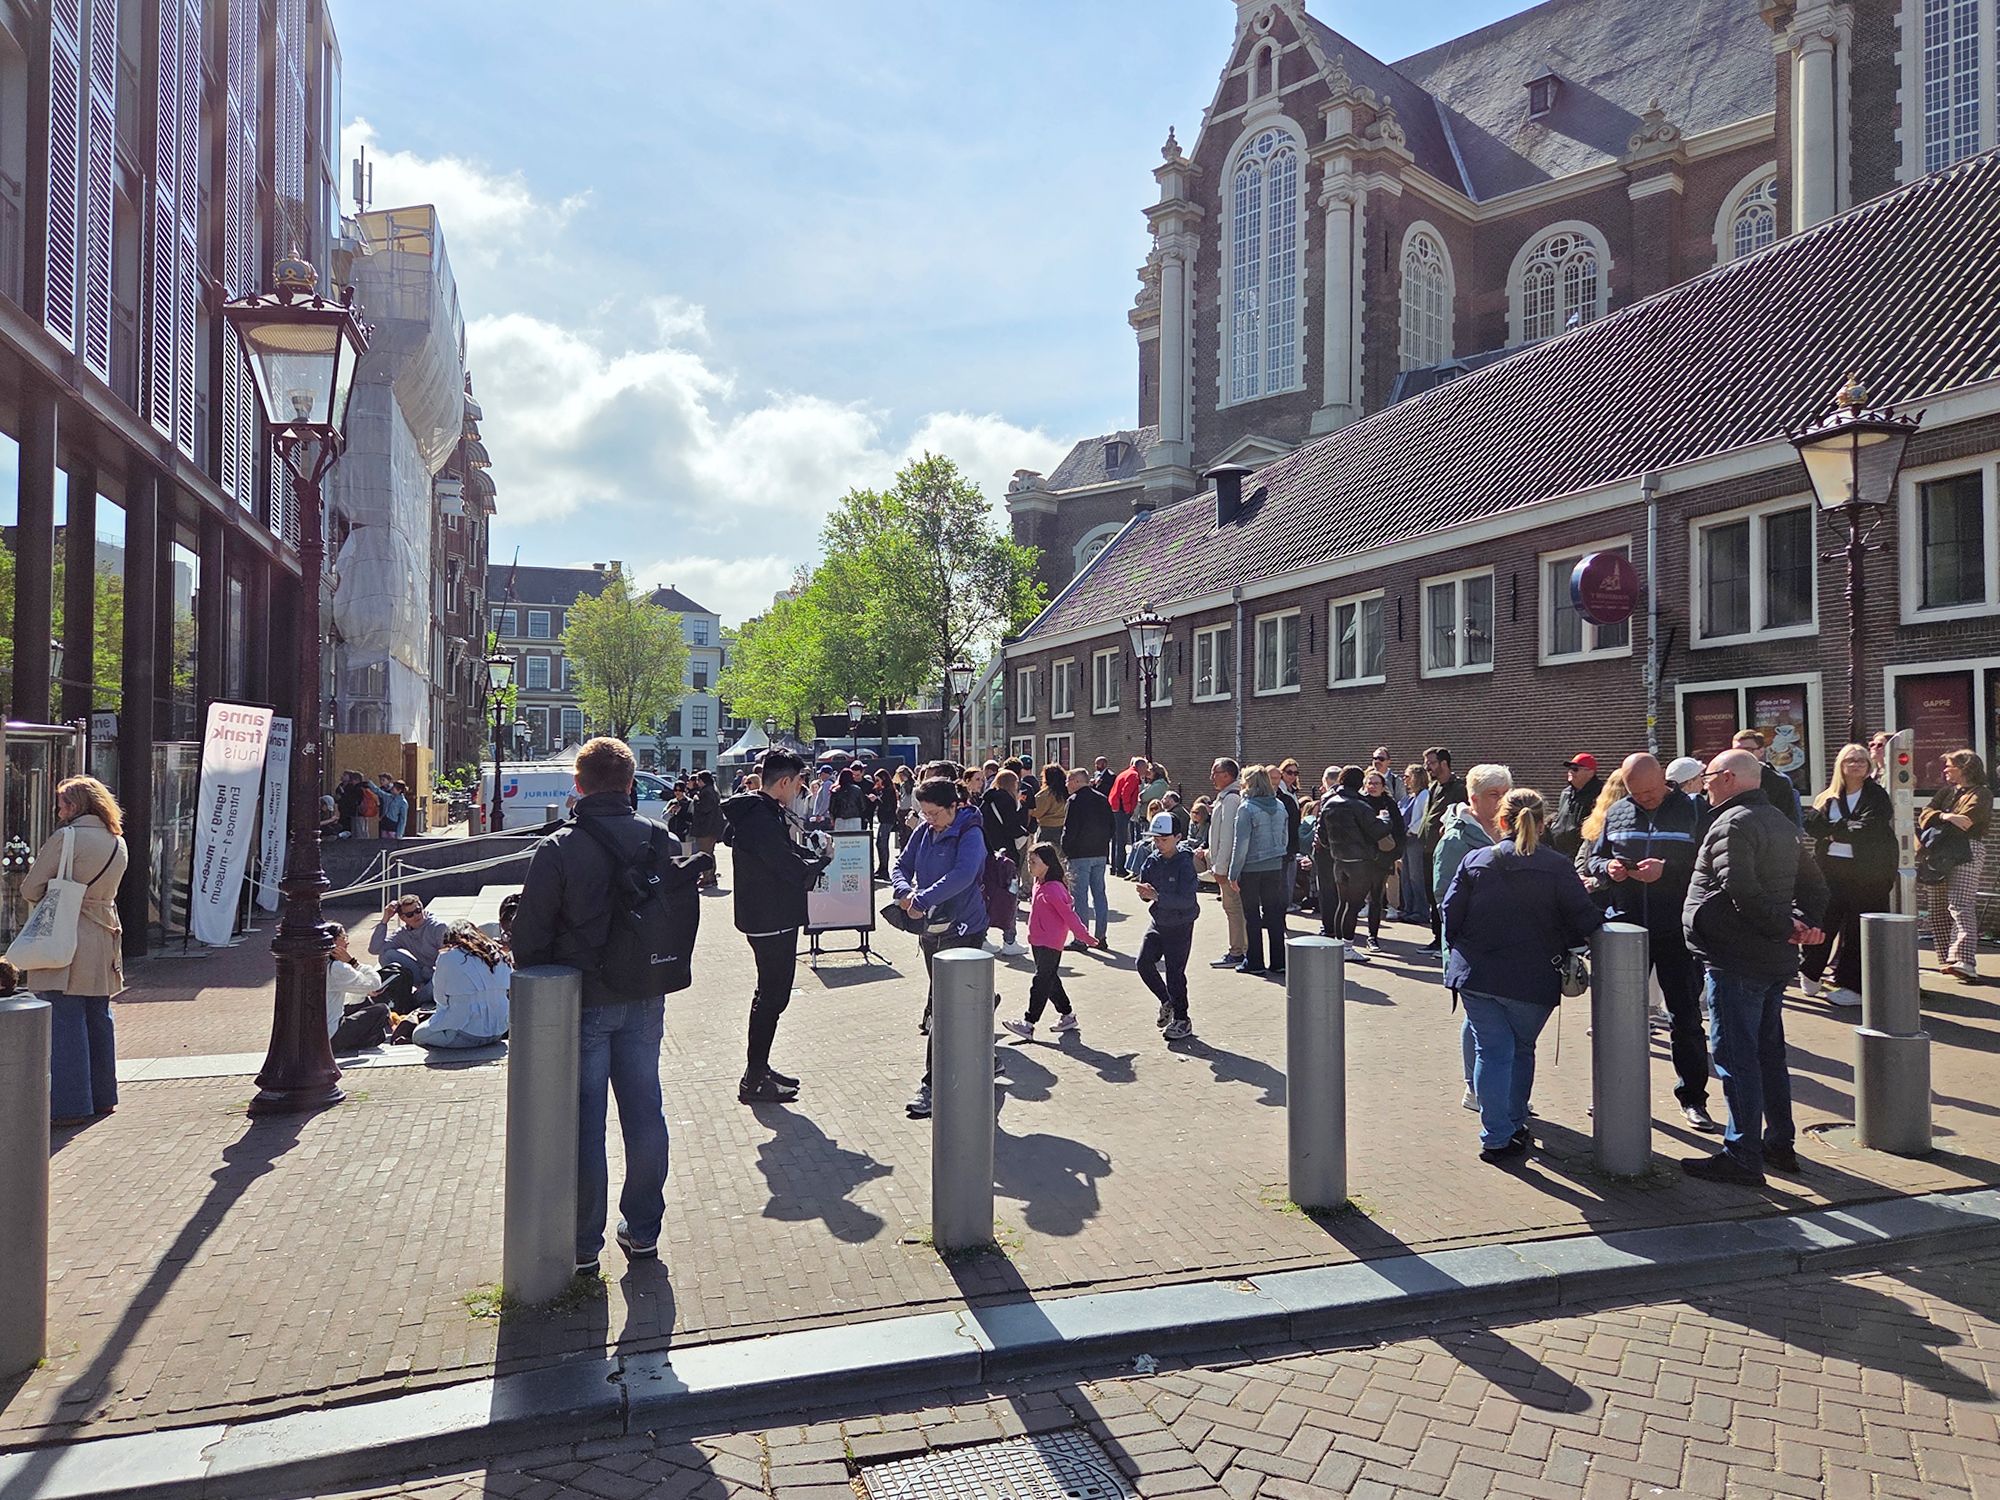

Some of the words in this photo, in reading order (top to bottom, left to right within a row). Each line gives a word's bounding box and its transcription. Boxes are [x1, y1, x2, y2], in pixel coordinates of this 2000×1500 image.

[1923, 699, 1951, 708] GAPPIE
[524, 789, 570, 799] JURRIËN
[5, 841, 27, 849] Push
